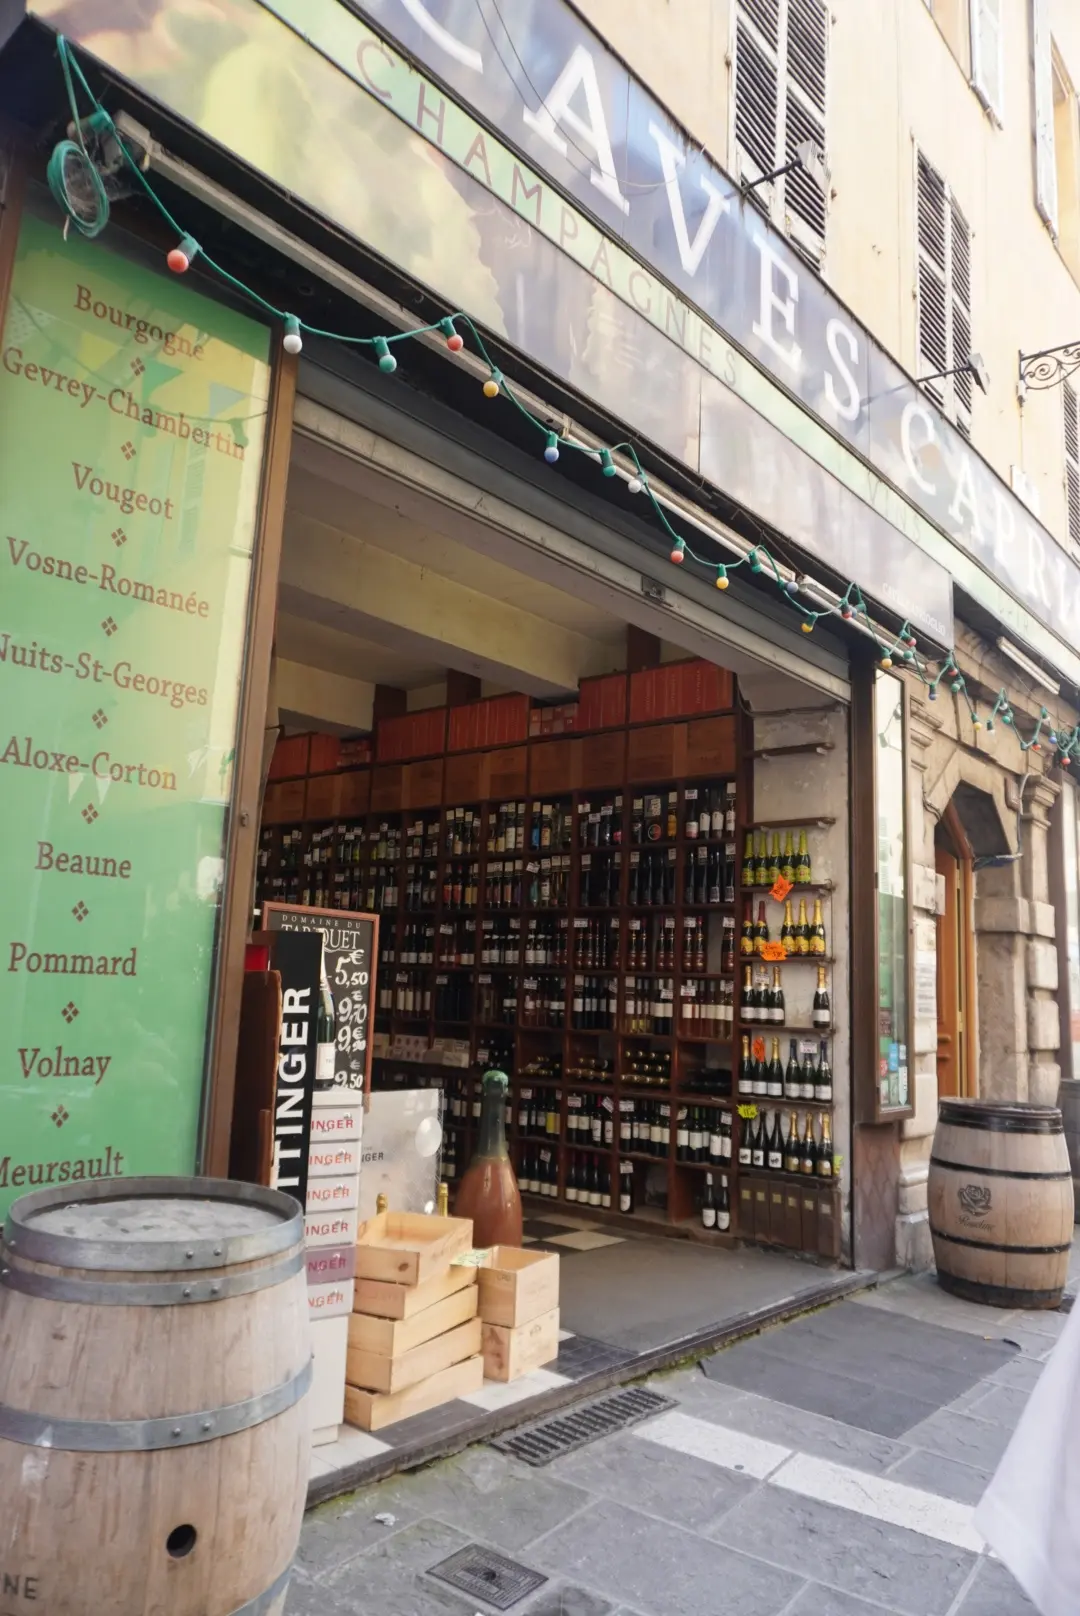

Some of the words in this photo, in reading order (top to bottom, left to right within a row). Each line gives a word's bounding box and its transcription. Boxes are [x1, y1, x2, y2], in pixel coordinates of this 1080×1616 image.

[355, 38, 738, 387] CHAMPAGNES
[74, 284, 205, 361] Bourgogne
[2, 346, 246, 460] Gevrey-Chambertin
[71, 462, 174, 520] Vougeot
[900, 400, 1080, 632] CAPRI
[6, 536, 210, 618] Vosne-Romanée
[0, 736, 177, 791] Aloxe-Corton
[35, 842, 132, 879] Beaune
[282, 914, 339, 927] DOMAINE
[8, 943, 137, 976] Pommard
[18, 1046, 112, 1086] Volnay
[311, 1119, 353, 1130] INGER
[309, 1153, 352, 1165] INGER
[307, 1187, 350, 1201] INGER
[305, 1222, 349, 1237] INGER
[2, 1572, 40, 1600] NE
